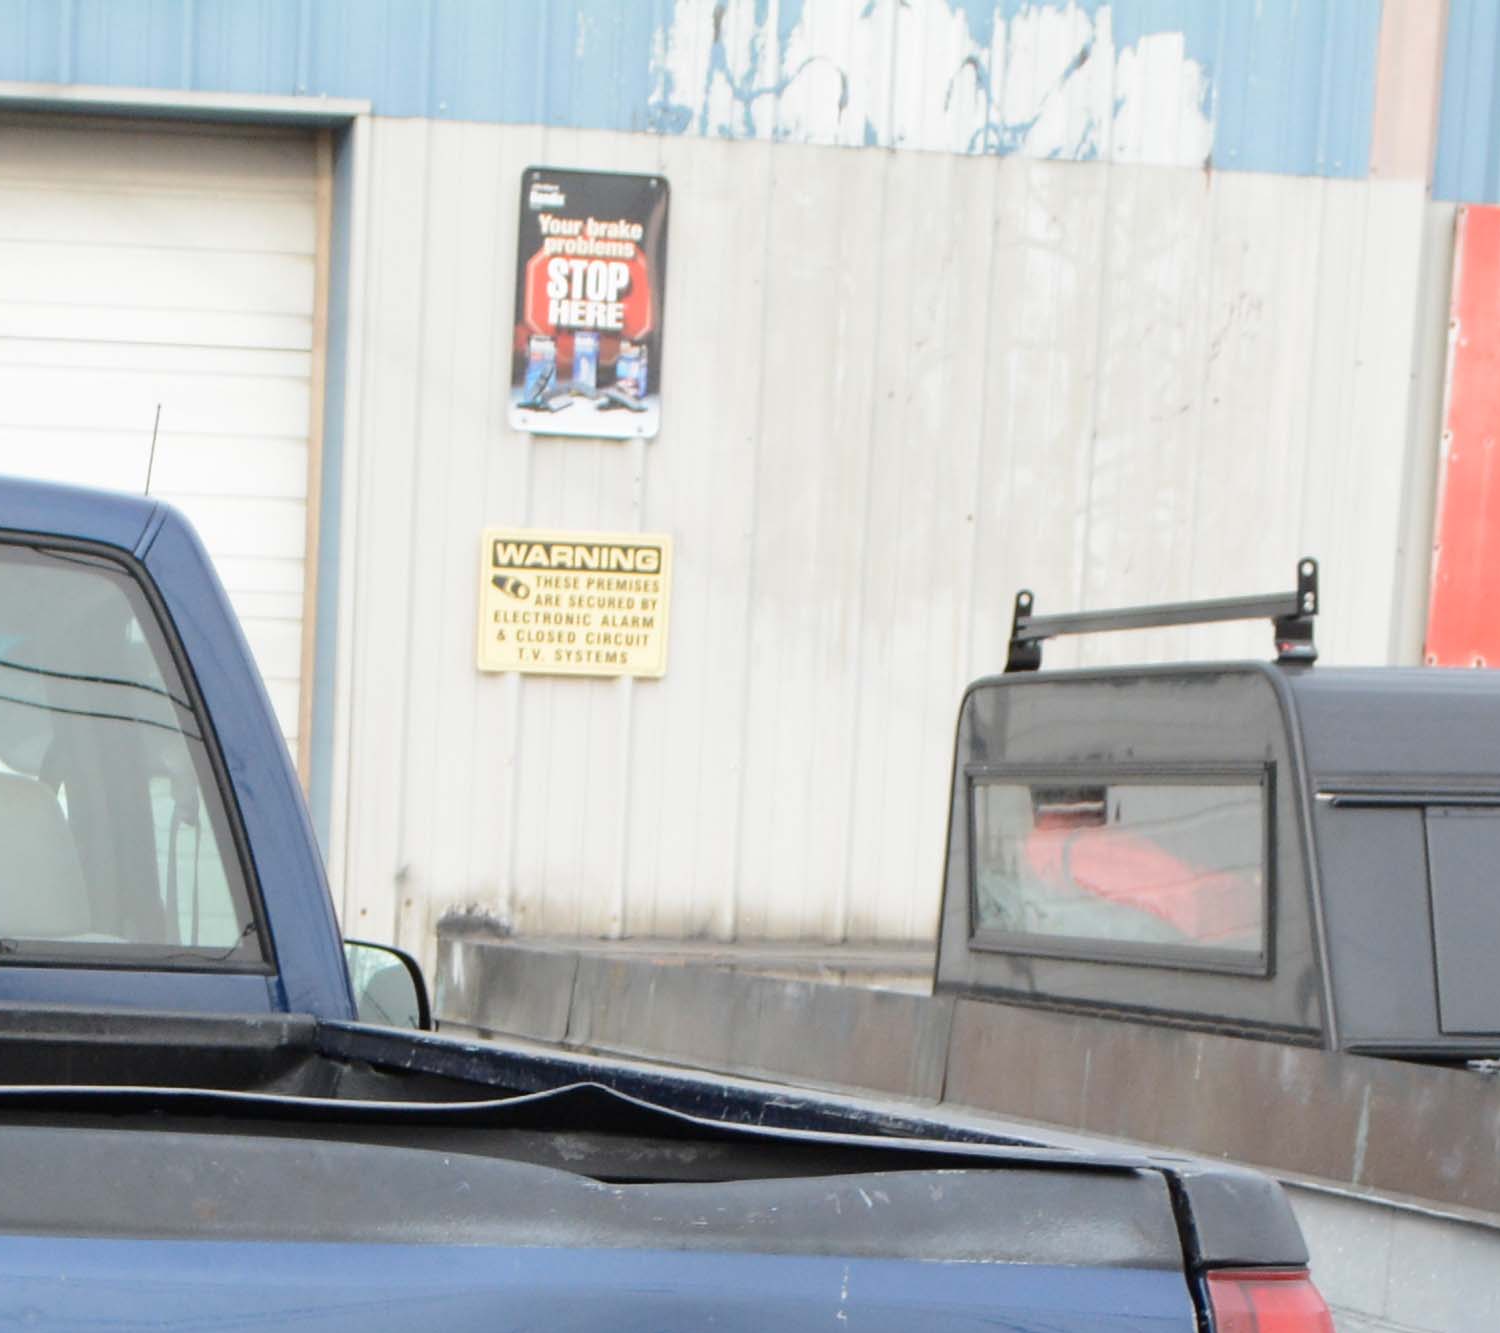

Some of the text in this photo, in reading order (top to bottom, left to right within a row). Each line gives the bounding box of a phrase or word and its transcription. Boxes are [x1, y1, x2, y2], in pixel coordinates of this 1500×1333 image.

[538, 213, 643, 241] Your brake
[543, 236, 636, 259] problems
[547, 256, 630, 301] STOP
[548, 299, 625, 330] HERE
[496, 542, 660, 573] WARNING
[535, 575, 660, 593] THESE PREMISES
[534, 593, 658, 611] ARE SECURED BY
[493, 610, 655, 629] ELECTRONIC ALARM
[515, 629, 577, 644] CLOSED
[585, 632, 650, 646] CIRCUIT
[554, 648, 629, 664] SYSTEMS
